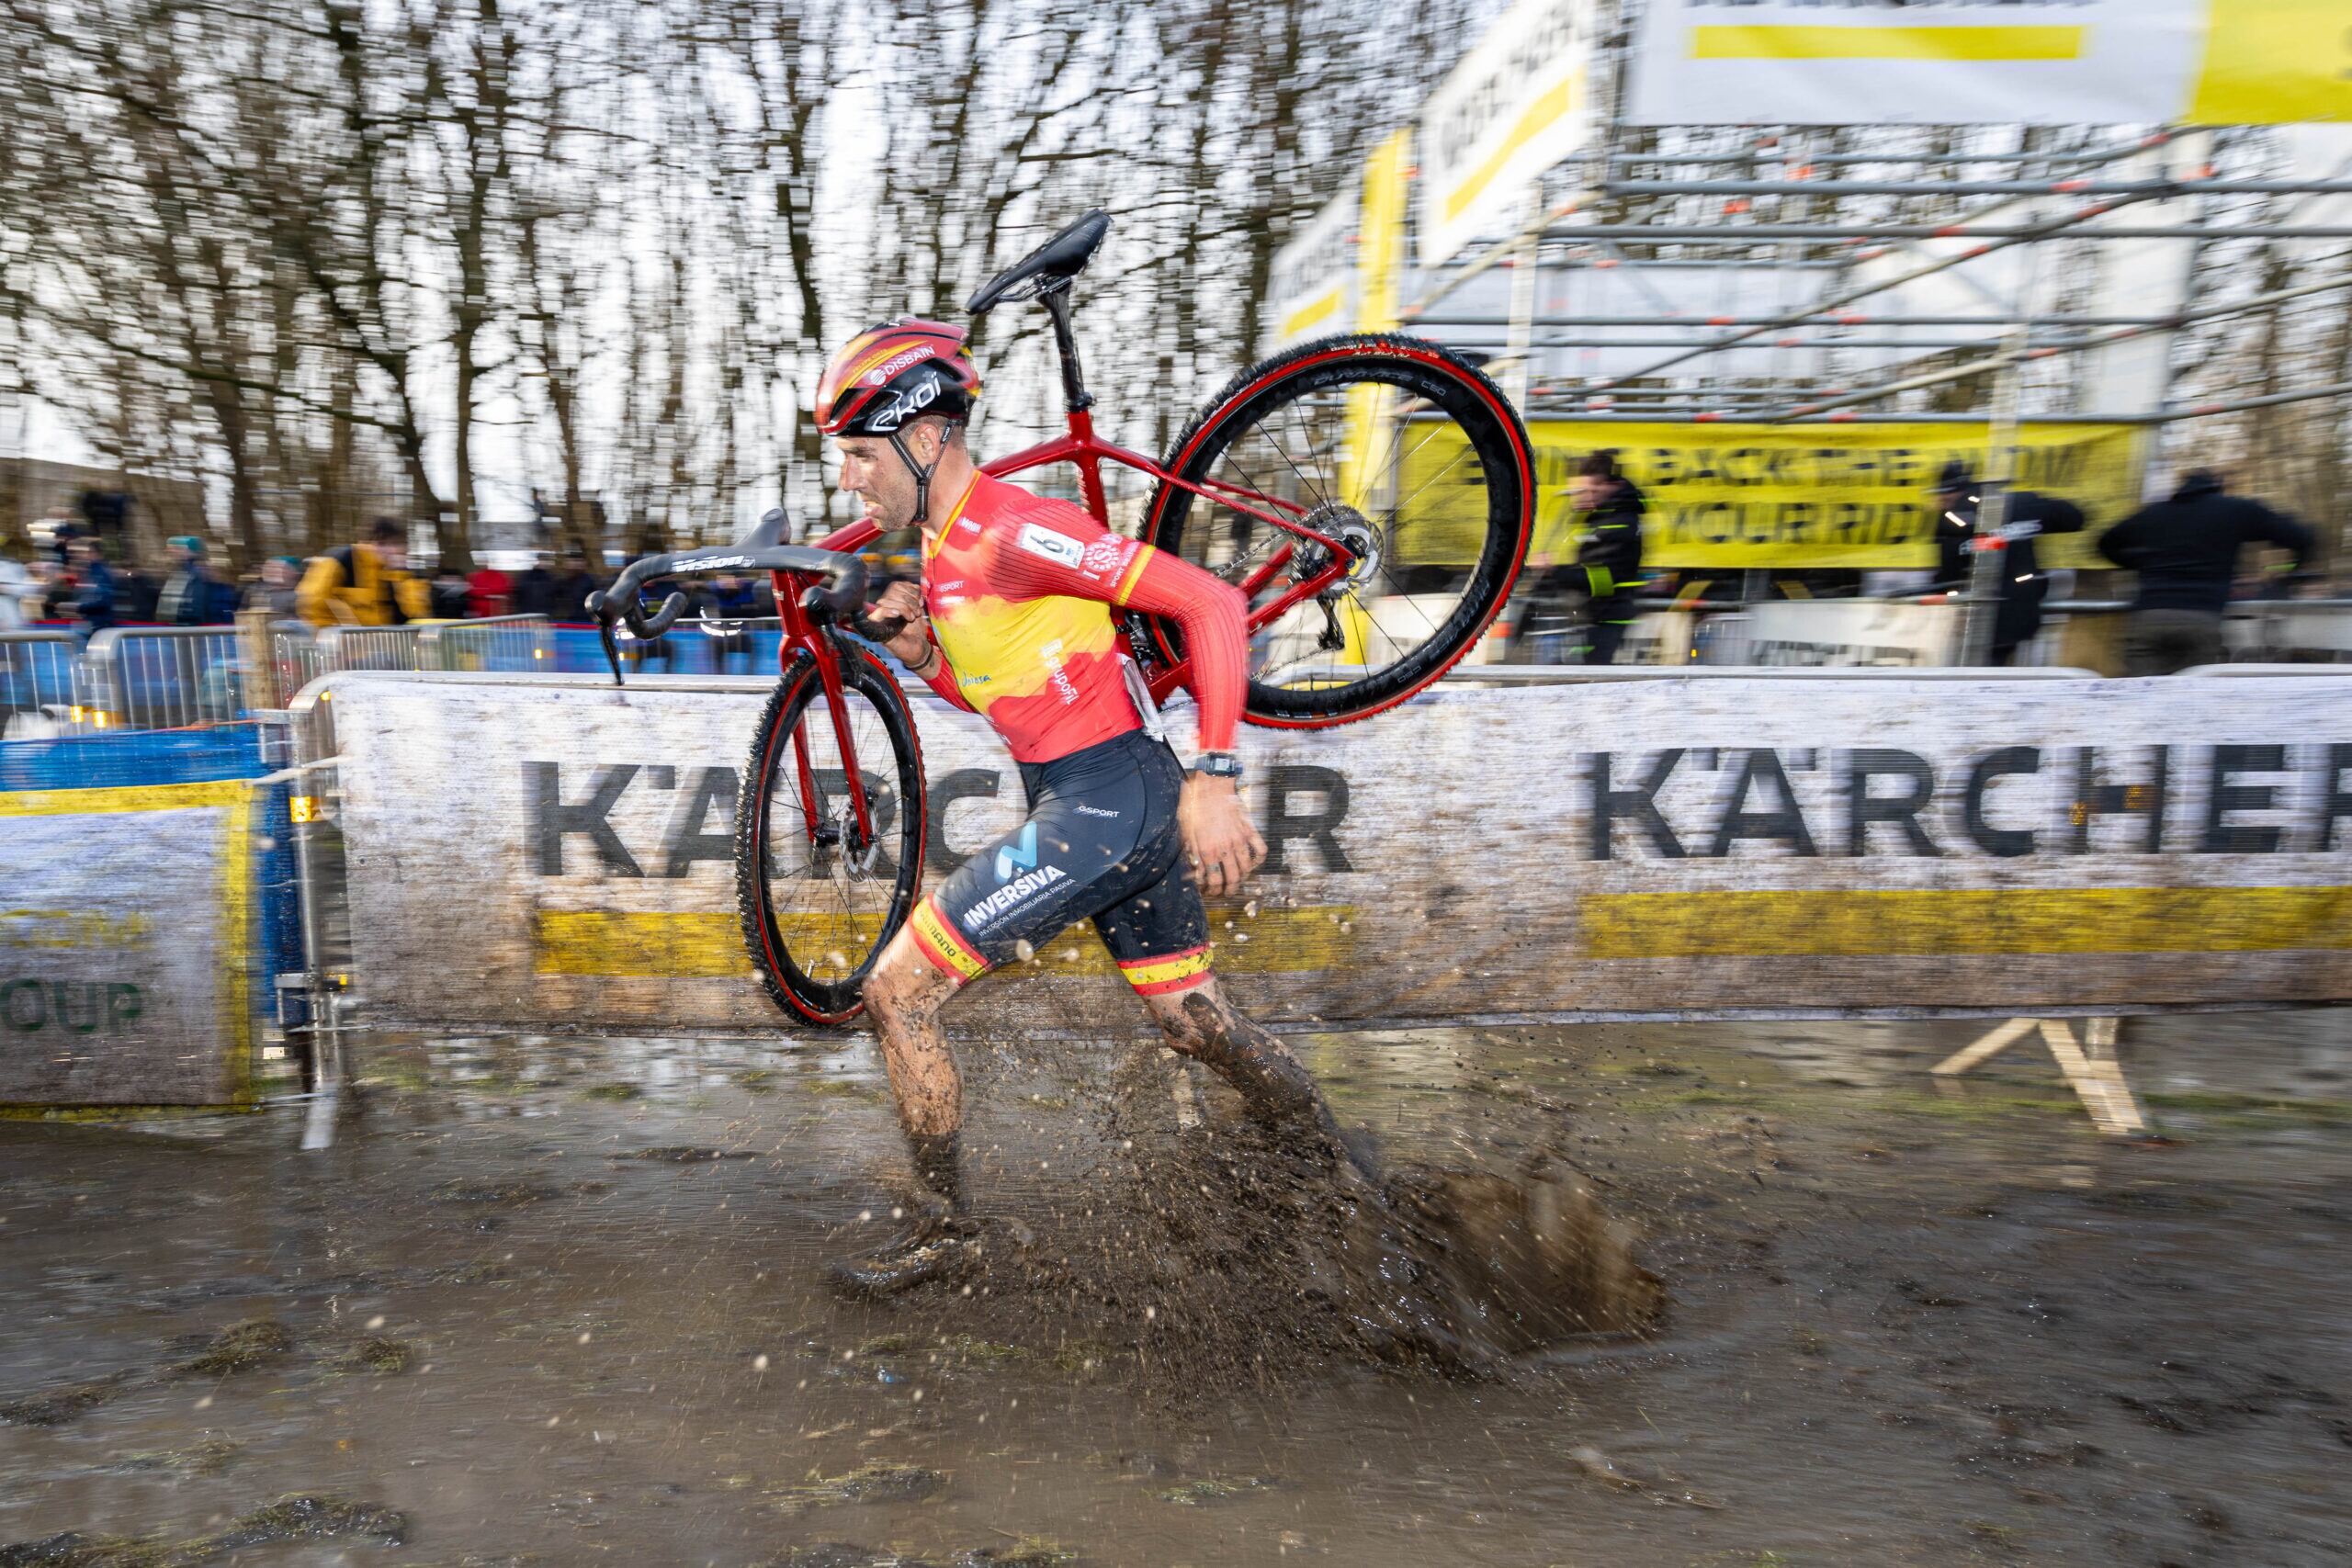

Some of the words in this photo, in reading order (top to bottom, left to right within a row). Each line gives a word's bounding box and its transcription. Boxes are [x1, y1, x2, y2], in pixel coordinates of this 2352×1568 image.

[1078, 806, 1121, 818] GSPORT
[1050, 878, 1077, 895] PASIVA
[964, 864, 1068, 928] INVERSIVA
